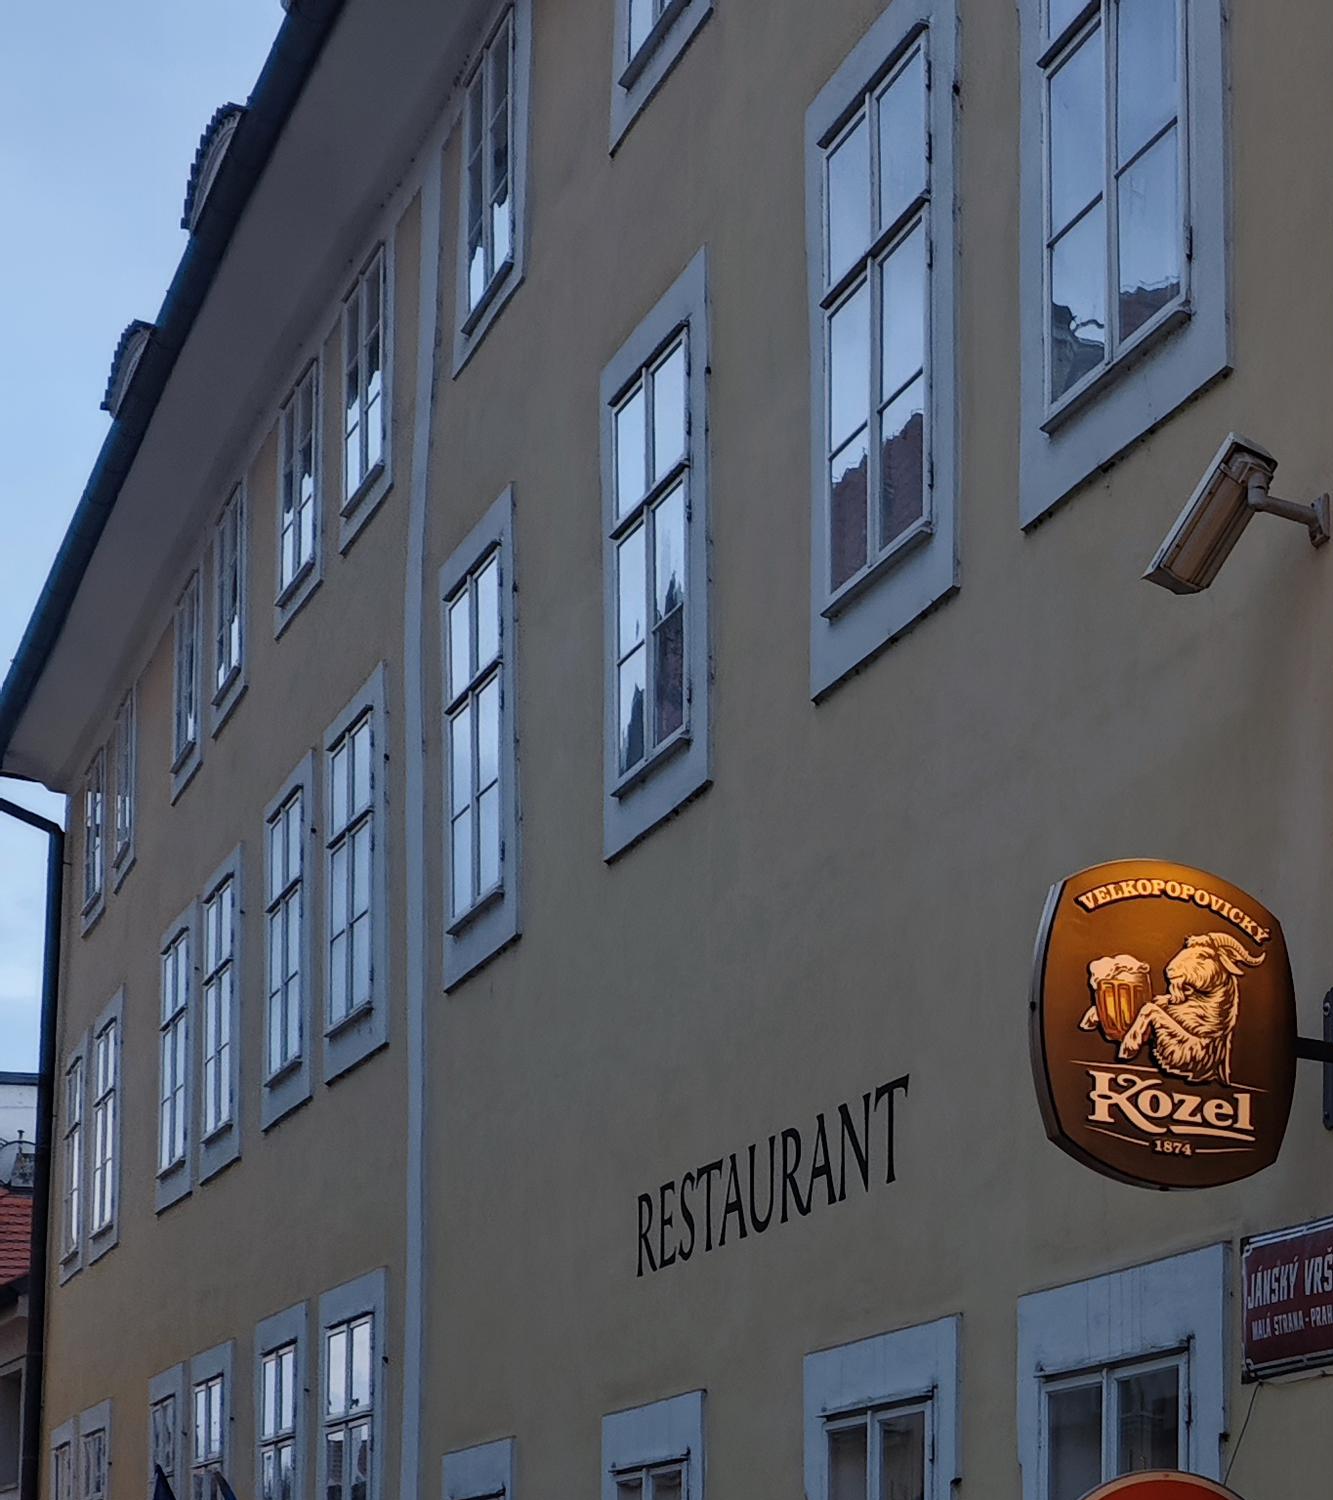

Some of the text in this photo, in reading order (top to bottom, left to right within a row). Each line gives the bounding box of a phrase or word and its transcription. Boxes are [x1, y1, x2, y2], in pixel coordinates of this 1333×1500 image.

[1077, 878, 1271, 943] VELKOPOPOVICKÝ
[1087, 1069, 1256, 1135] Kozel
[636, 1072, 911, 1278] RESTAURANT
[1154, 1140, 1193, 1156] 1874
[1247, 1255, 1299, 1309] JÁNSKÝ
[1252, 1312, 1272, 1341] MALÁ
[1274, 1310, 1304, 1336] STRANA
